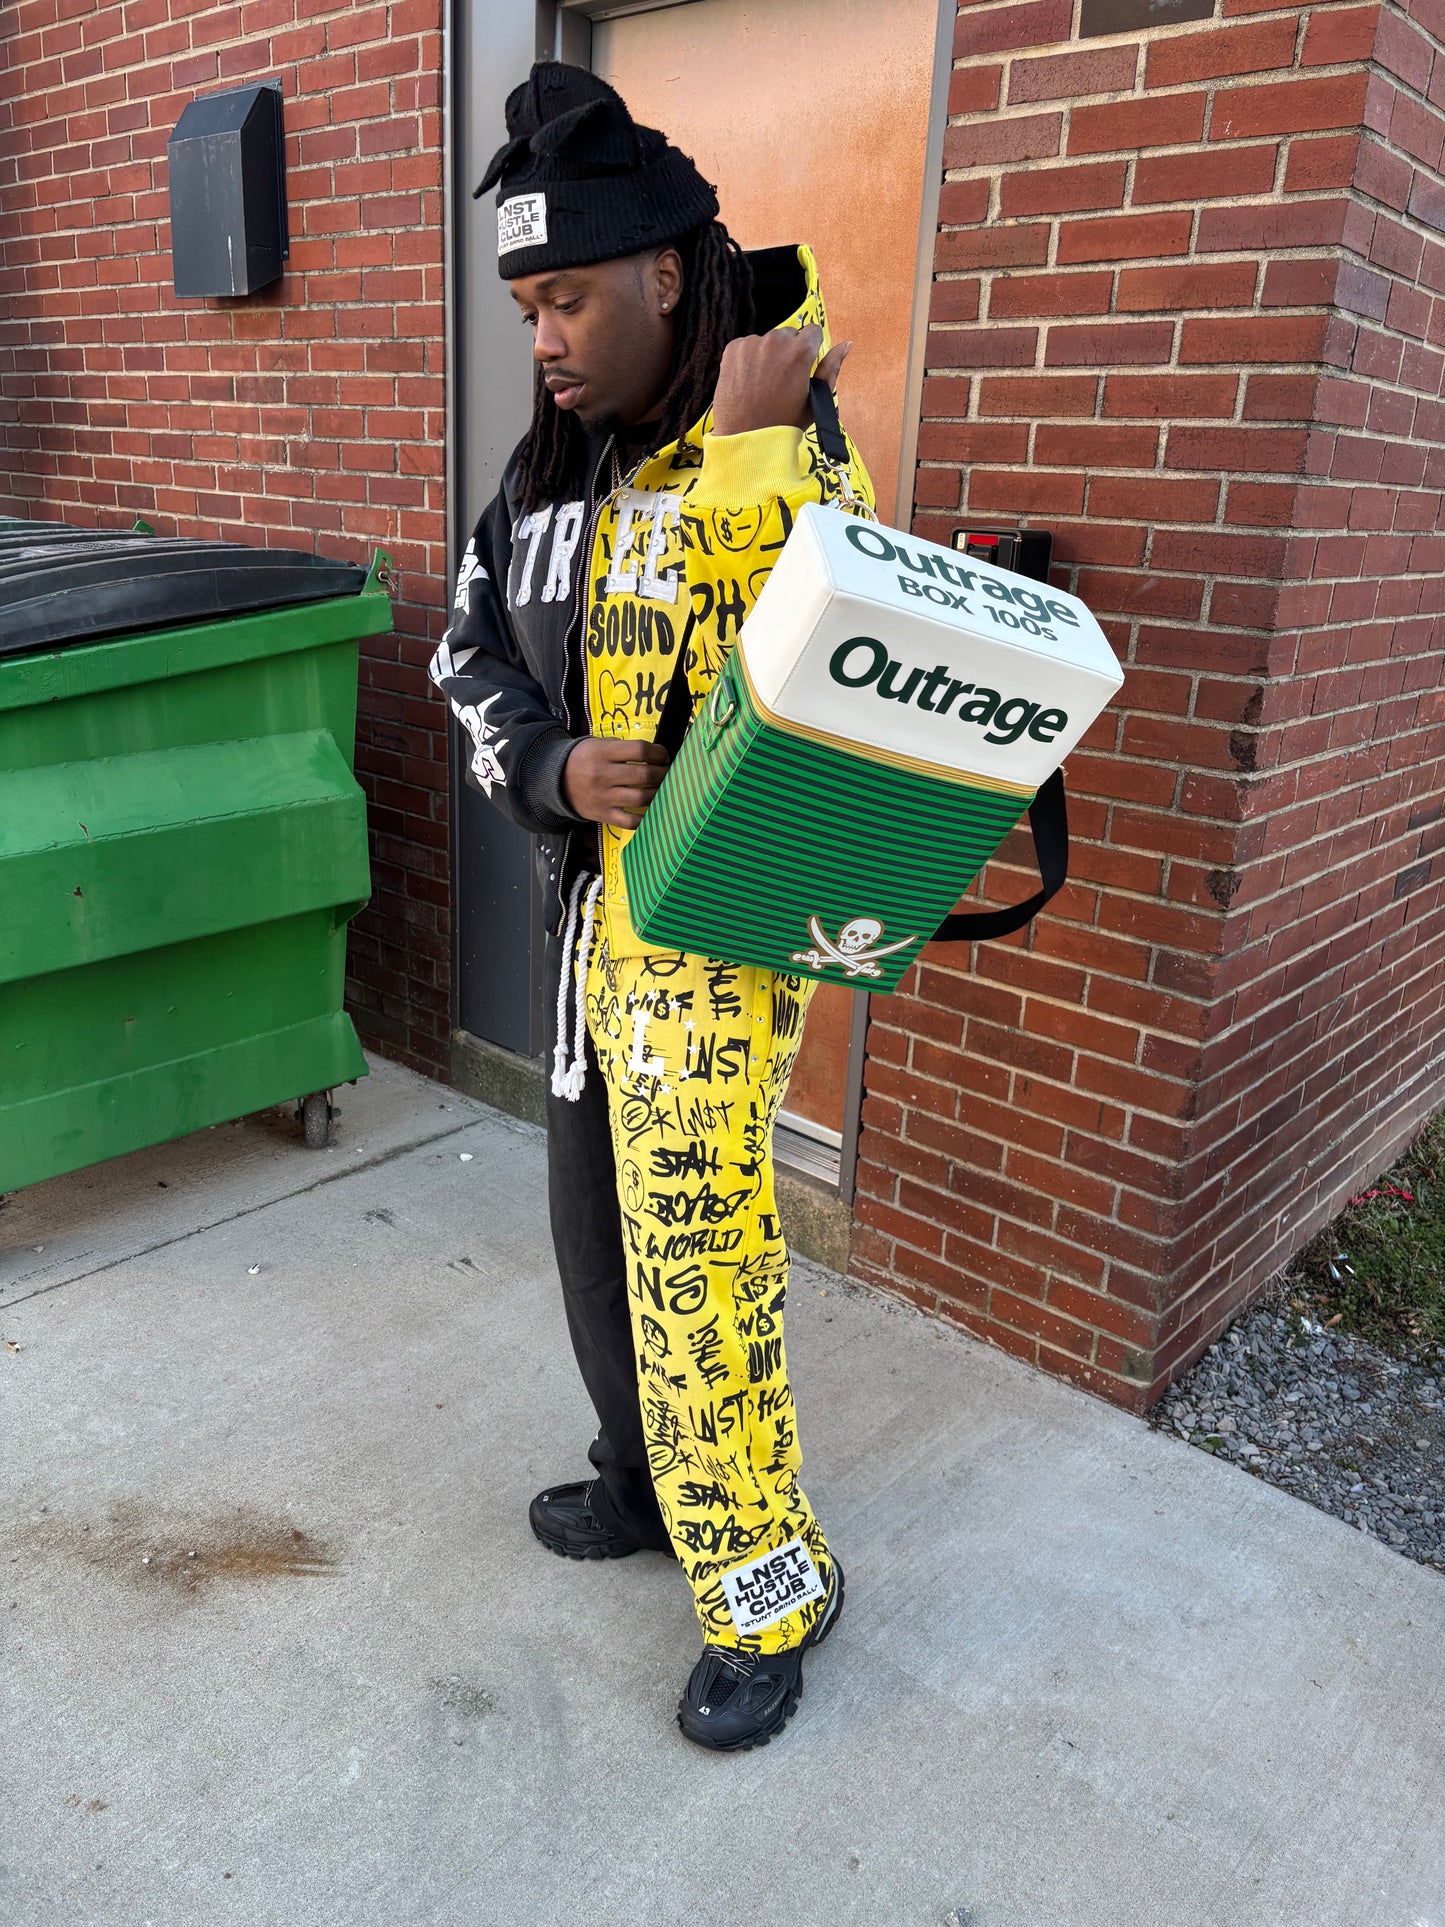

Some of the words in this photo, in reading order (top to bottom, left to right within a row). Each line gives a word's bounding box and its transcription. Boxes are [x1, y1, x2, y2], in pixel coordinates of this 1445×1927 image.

[501, 224, 533, 243] CLUB
[845, 525, 1081, 629] Outrage
[588, 600, 675, 658] SOUND
[897, 574, 974, 616] BOX
[983, 604, 1059, 642] 100s
[828, 636, 1069, 746] Outrage
[645, 1228, 744, 1266] WORLD
[734, 1560, 810, 1607] HUSTLE
[735, 1546, 801, 1592] LNST
[749, 1577, 806, 1616] CLUB
[699, 1706, 711, 1716] 43
